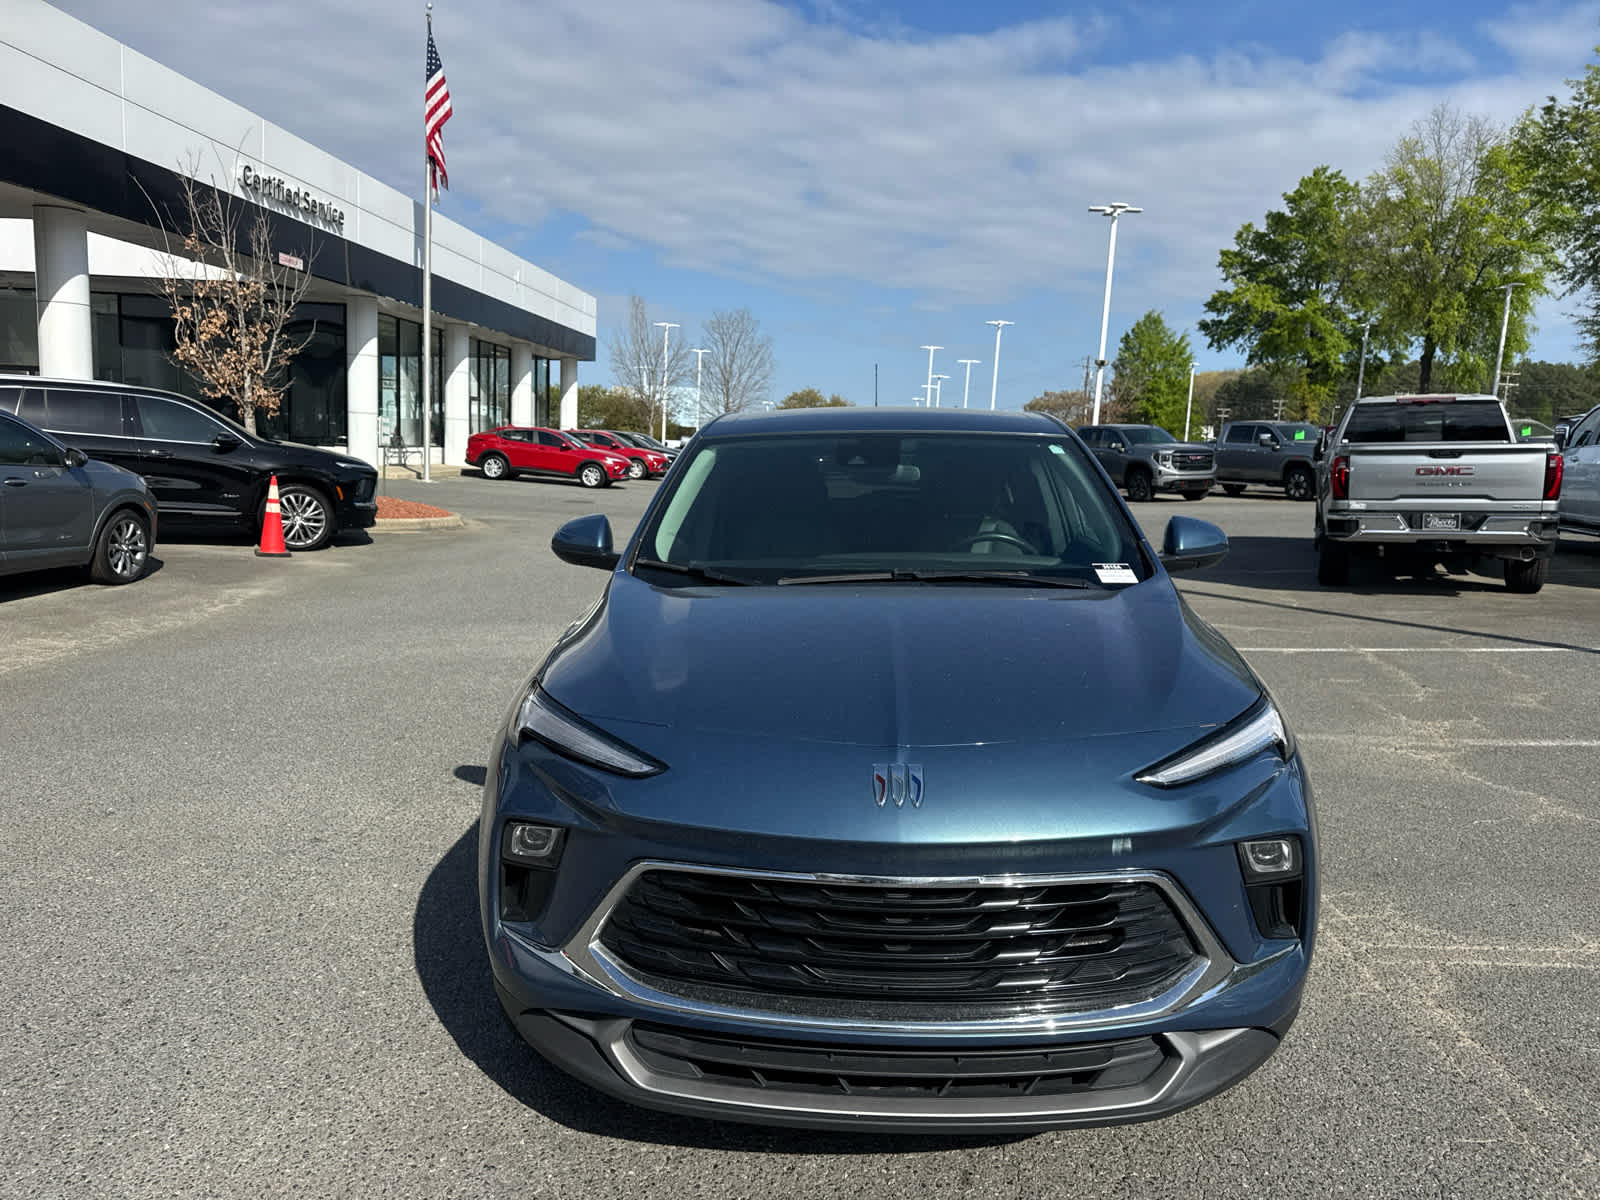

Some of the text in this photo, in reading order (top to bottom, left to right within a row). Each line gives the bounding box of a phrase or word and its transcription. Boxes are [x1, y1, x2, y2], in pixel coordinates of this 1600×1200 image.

[243, 165, 344, 226] Certified Service
[1416, 465, 1475, 476] GMC
